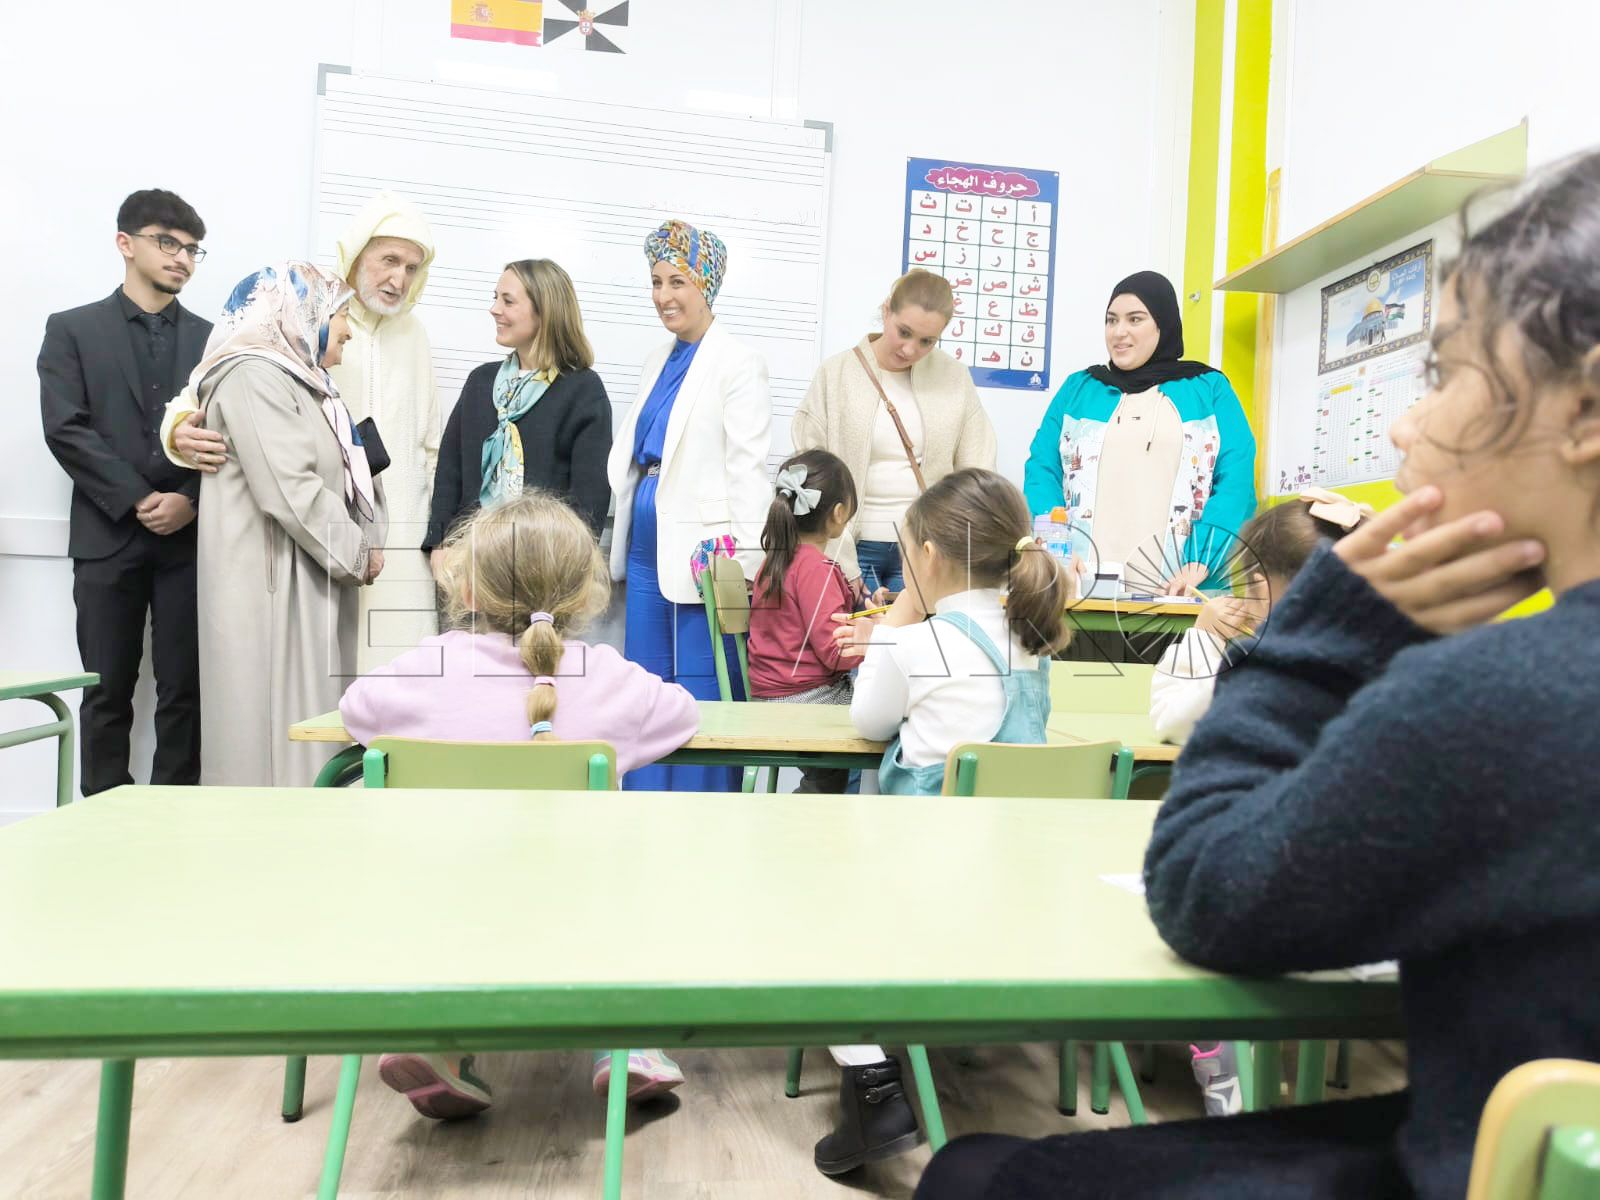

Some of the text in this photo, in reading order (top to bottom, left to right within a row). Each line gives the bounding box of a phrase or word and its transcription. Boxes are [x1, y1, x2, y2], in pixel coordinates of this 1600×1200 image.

[937, 173, 1028, 194] حروف الهجاء
[920, 193, 937, 209] ث
[955, 199, 972, 213] ت
[991, 205, 1007, 218] ب
[922, 221, 1039, 247] ج ح خ د
[914, 247, 1036, 268] ذ ر ز س
[950, 272, 1041, 295] ش ص ض
[988, 300, 1000, 317] ع
[1018, 302, 1039, 317] ظ
[951, 320, 1035, 343] ق ك ل
[955, 348, 963, 360] و
[1020, 351, 1033, 367] ن
